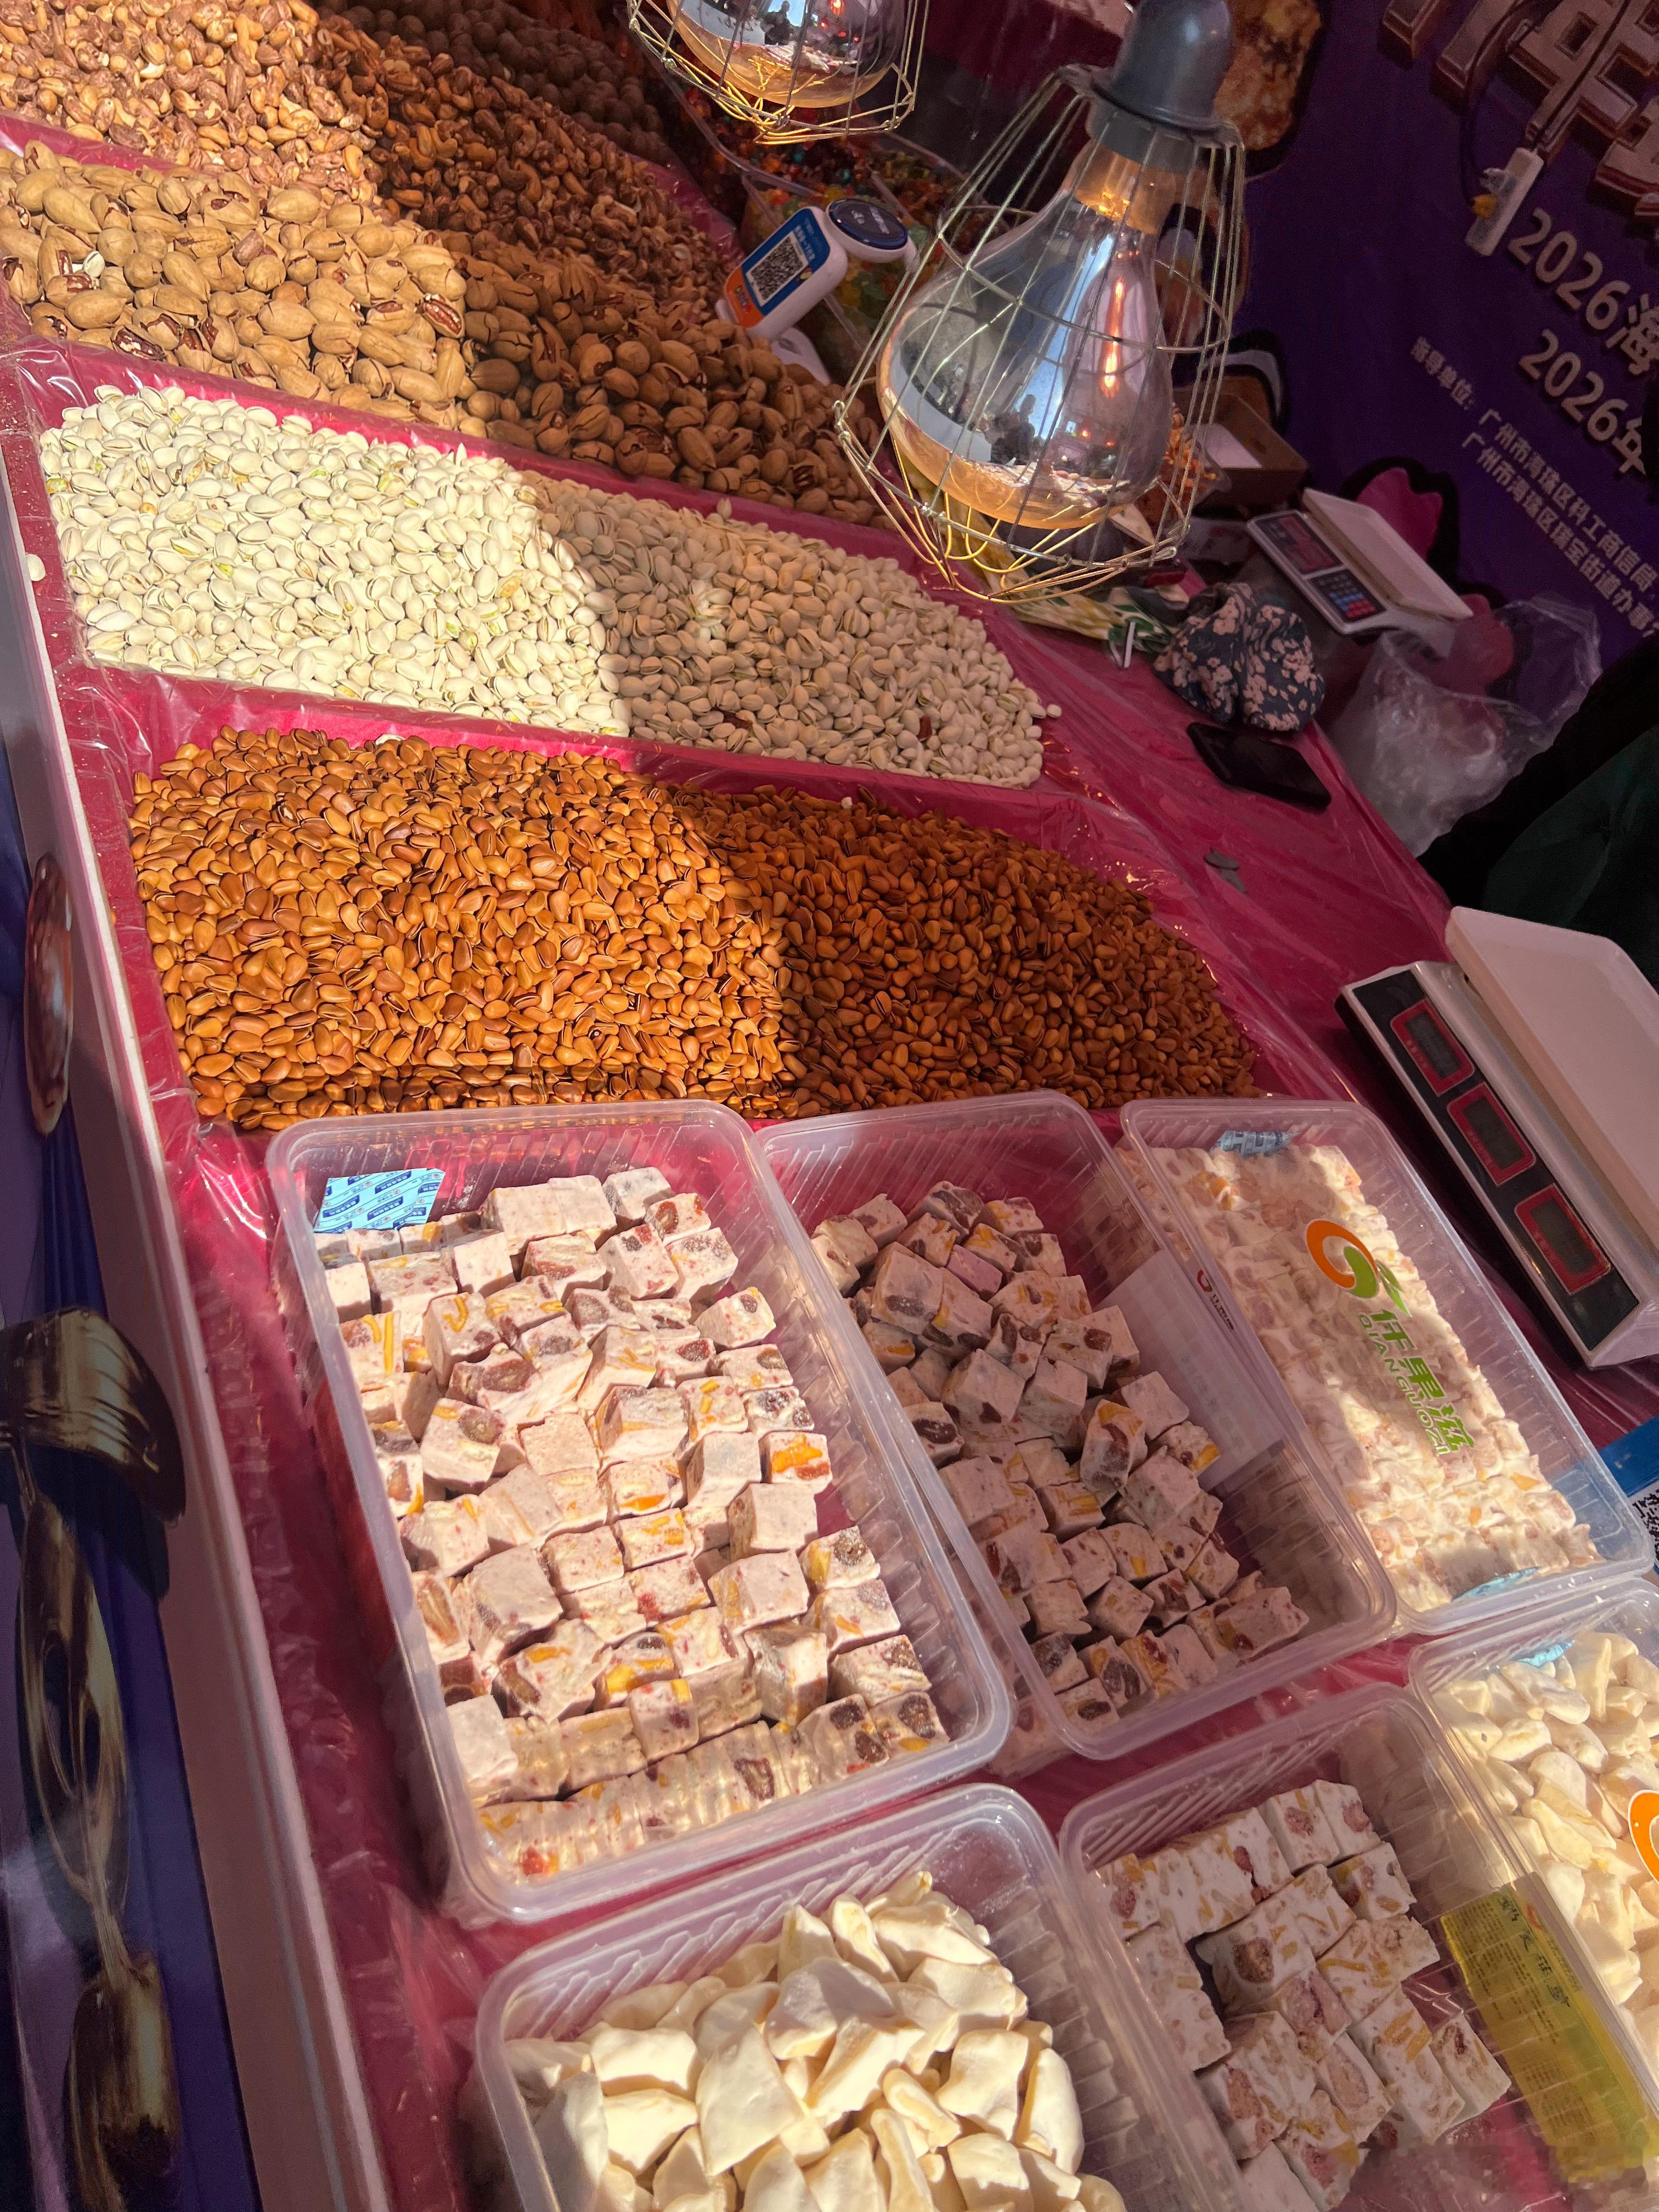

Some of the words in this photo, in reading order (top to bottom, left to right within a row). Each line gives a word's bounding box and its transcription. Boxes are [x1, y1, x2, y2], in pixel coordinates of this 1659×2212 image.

[1358, 1313, 1451, 1454] QIANGUOZI
[1370, 1308, 1475, 1452] 仟果滋
